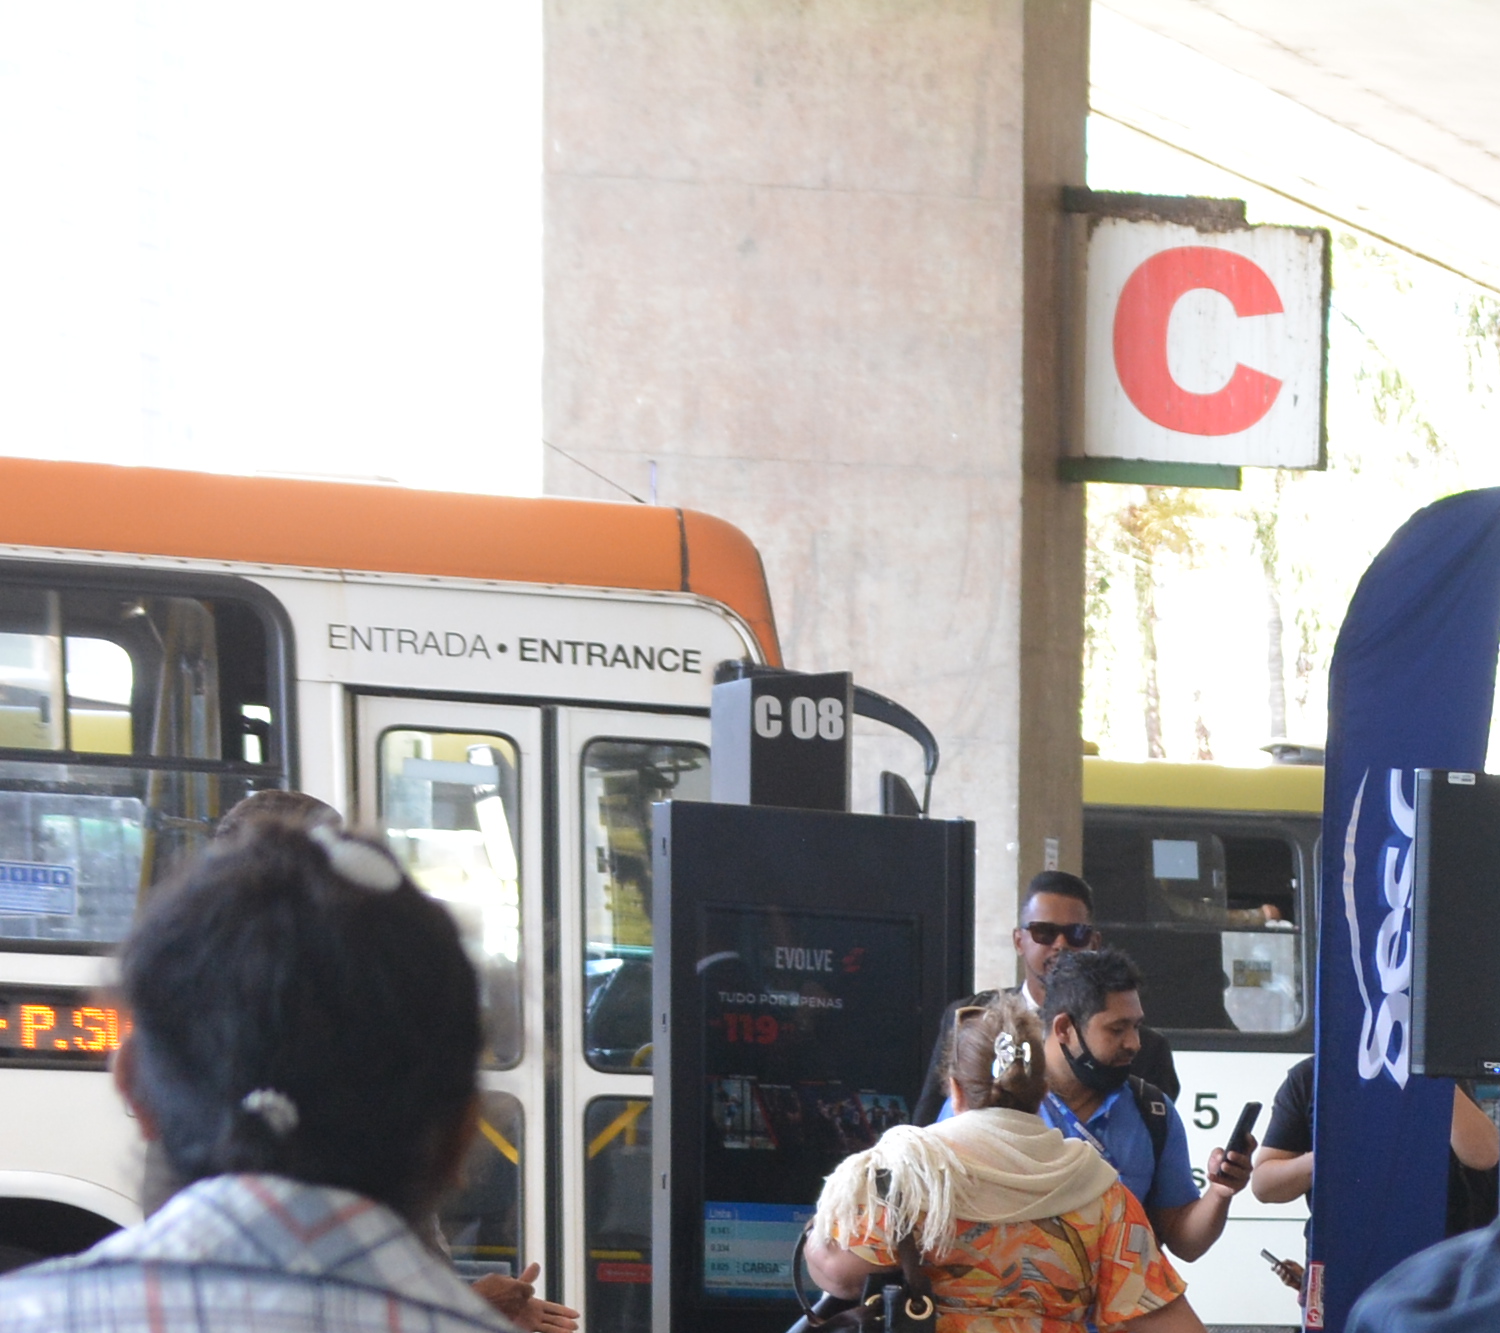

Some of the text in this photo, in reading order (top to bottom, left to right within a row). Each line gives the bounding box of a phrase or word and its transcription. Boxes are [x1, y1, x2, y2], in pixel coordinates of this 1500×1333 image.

[1113, 245, 1285, 436] C
[328, 622, 702, 675] ENTRADA ENTRANCE
[755, 696, 845, 741] C 08
[775, 946, 834, 972] EVOLVE
[718, 991, 844, 1009] TUDO POR APENAS
[724, 1012, 780, 1045] 119
[1193, 1092, 1220, 1130] 5
